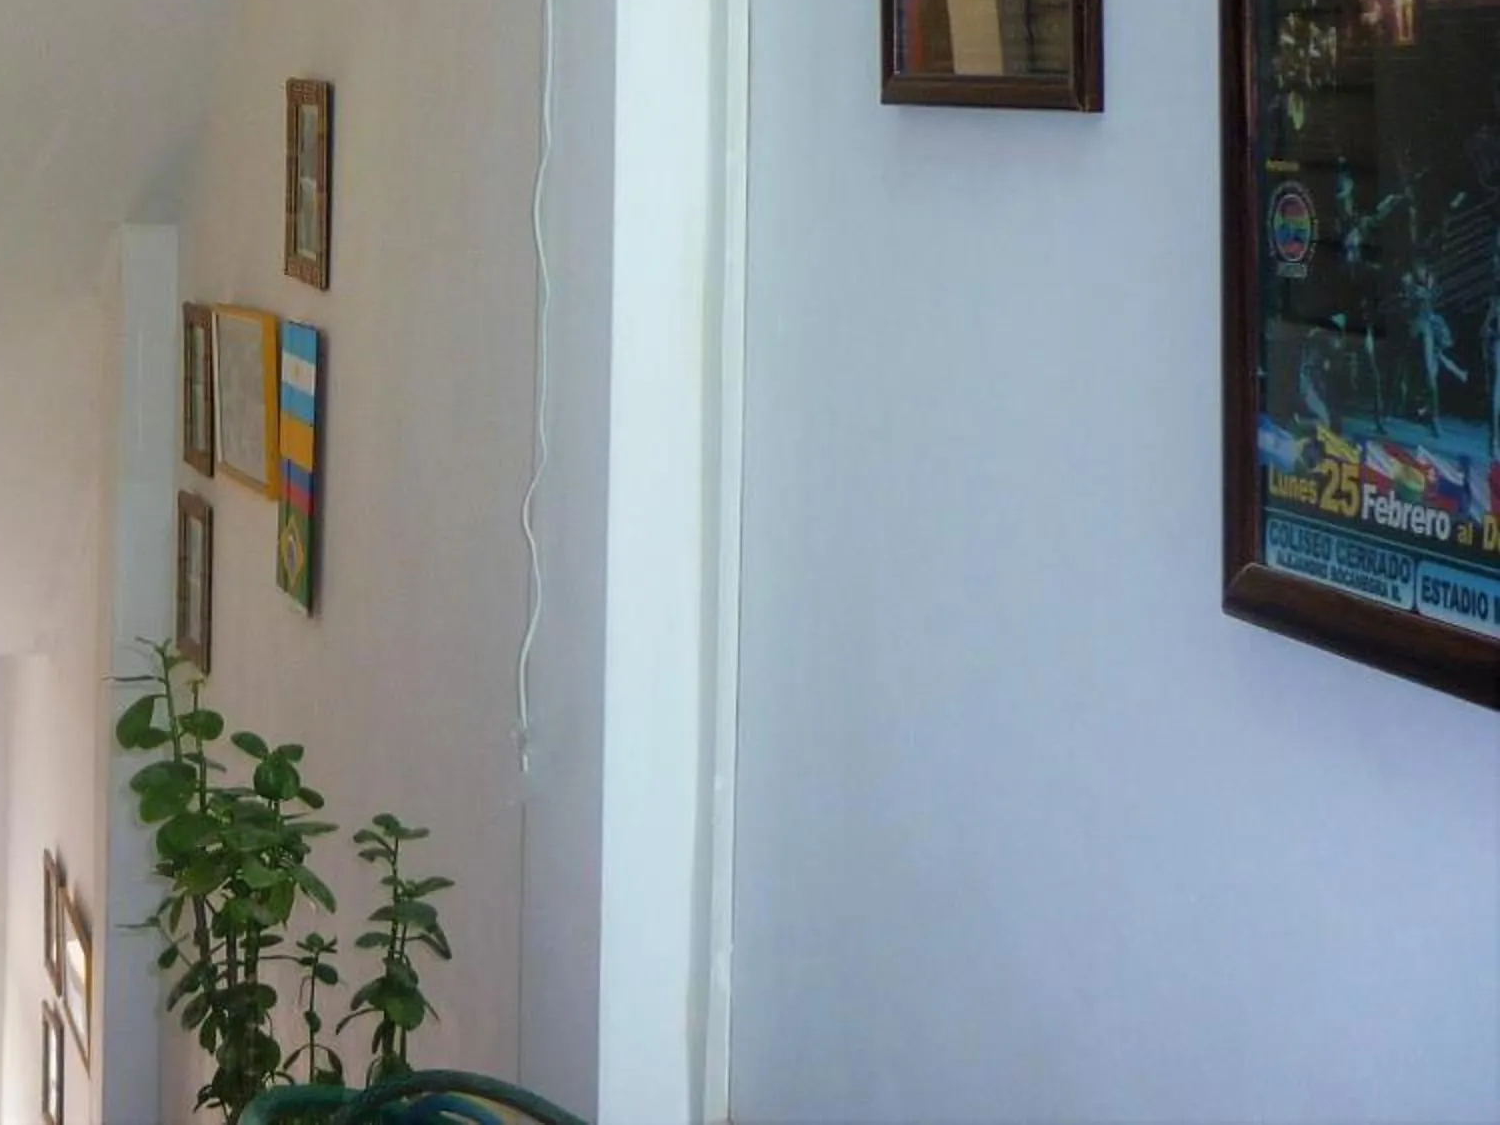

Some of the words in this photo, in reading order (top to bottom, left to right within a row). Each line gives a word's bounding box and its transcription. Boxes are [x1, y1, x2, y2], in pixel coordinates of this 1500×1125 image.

[1268, 465, 1319, 505] Lunes
[1319, 462, 1361, 518] 25
[1361, 483, 1451, 541] Febrero
[1457, 522, 1474, 546] al
[1334, 536, 1412, 584] CERRADO
[1421, 575, 1489, 621] ESTADIO
